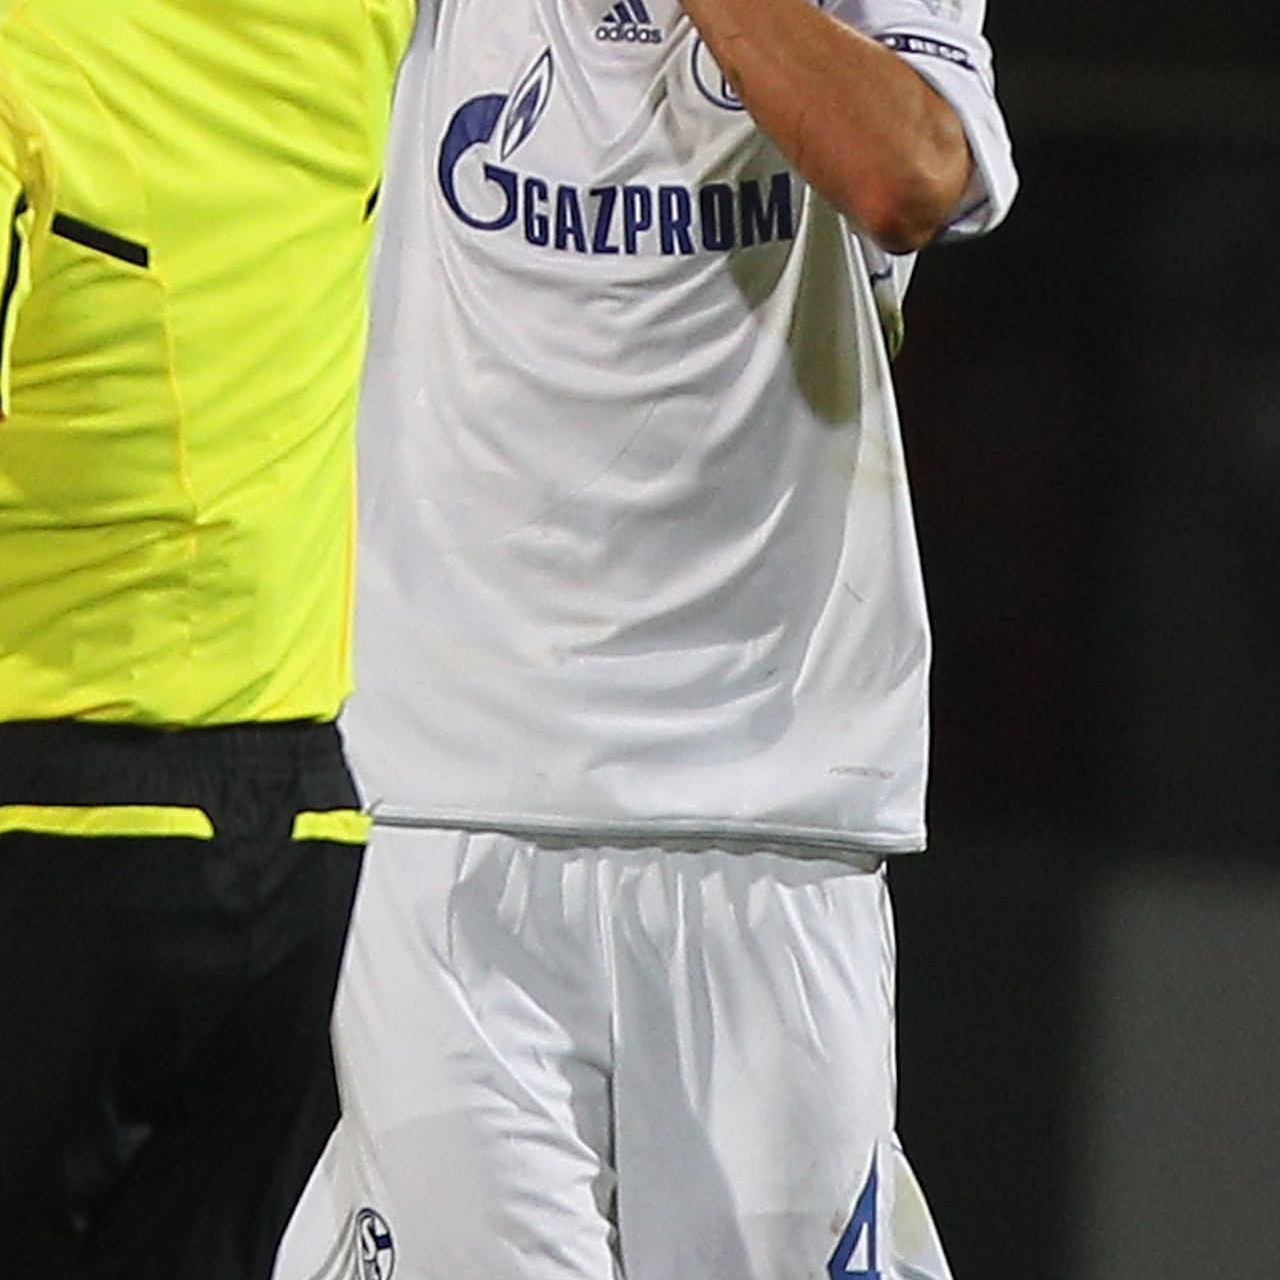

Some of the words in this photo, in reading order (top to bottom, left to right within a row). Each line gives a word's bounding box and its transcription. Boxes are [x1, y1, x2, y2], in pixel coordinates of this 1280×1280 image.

[595, 20, 662, 44] adidas
[907, 38, 968, 62] RESP
[523, 173, 794, 255] GAZPROM
